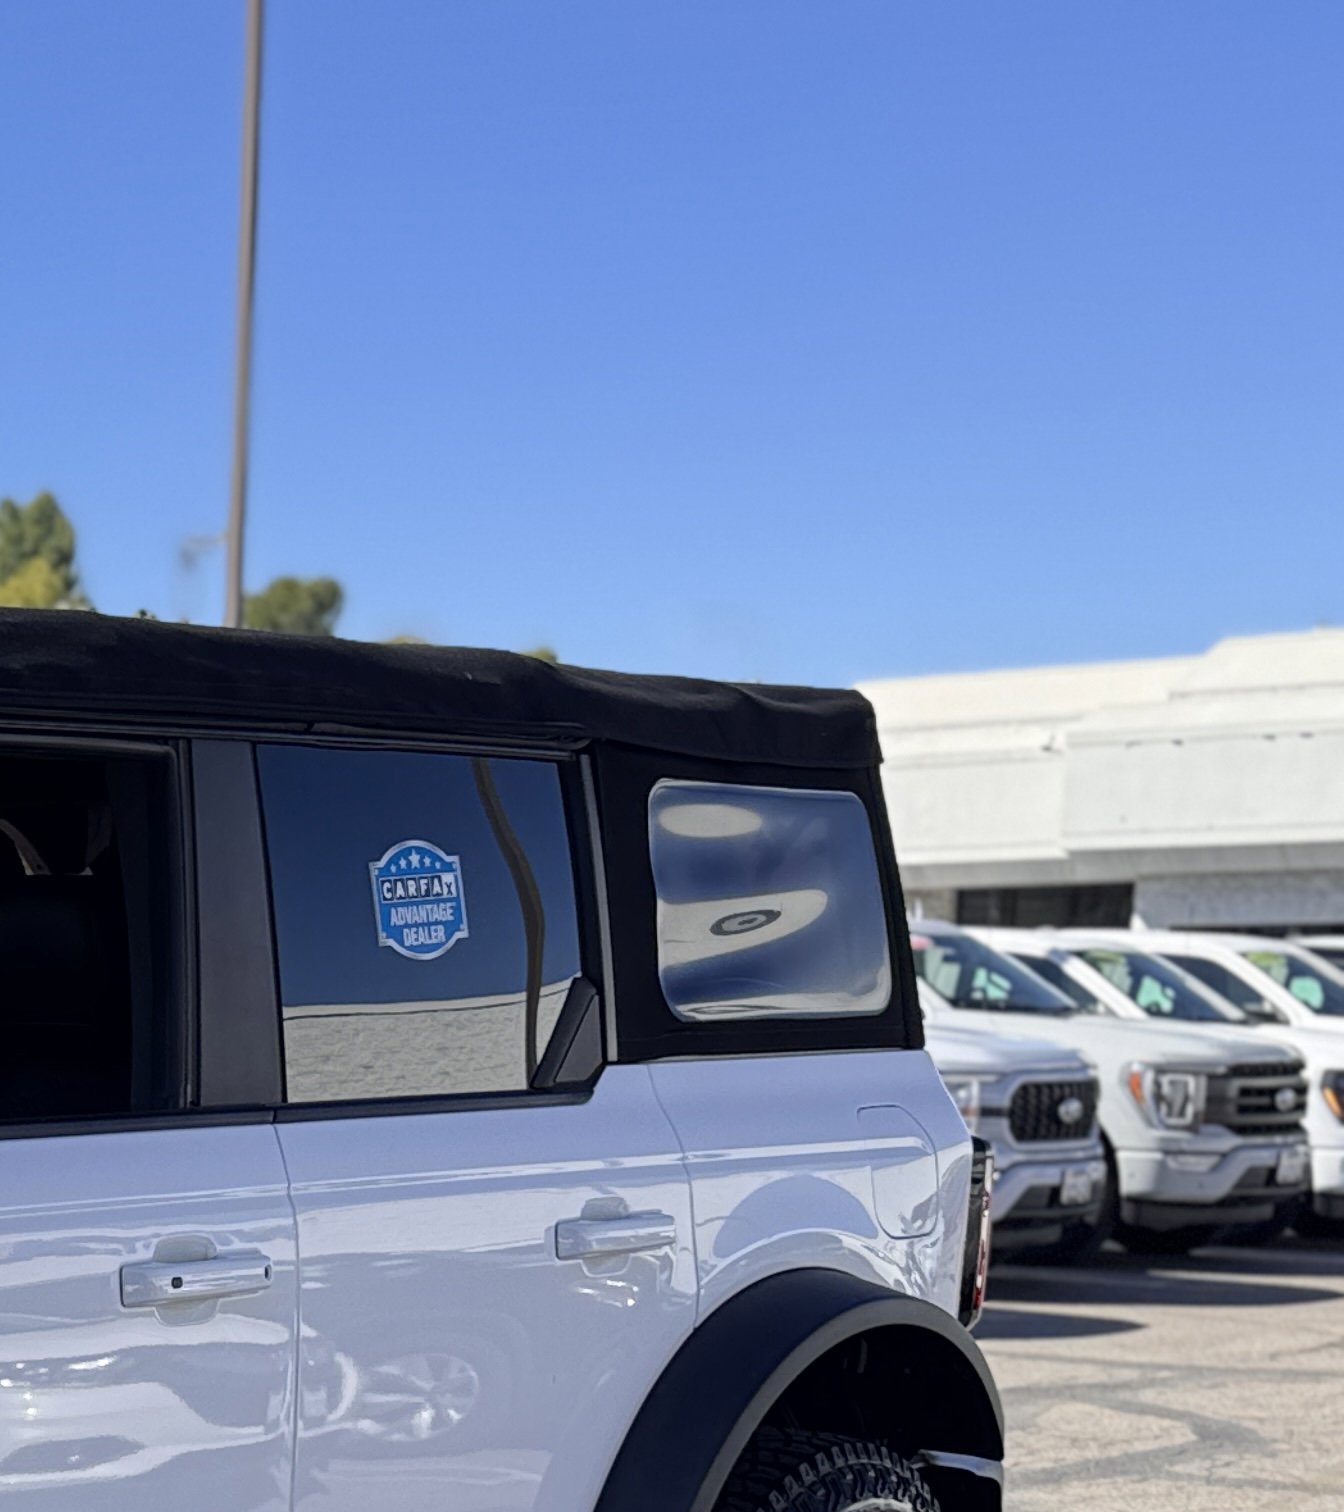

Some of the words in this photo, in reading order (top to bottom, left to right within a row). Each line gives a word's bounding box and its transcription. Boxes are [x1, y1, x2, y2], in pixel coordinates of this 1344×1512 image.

[382, 876, 456, 900] CARFAX
[390, 902, 456, 926] ADVANTAGE
[402, 924, 447, 947] DEALER
